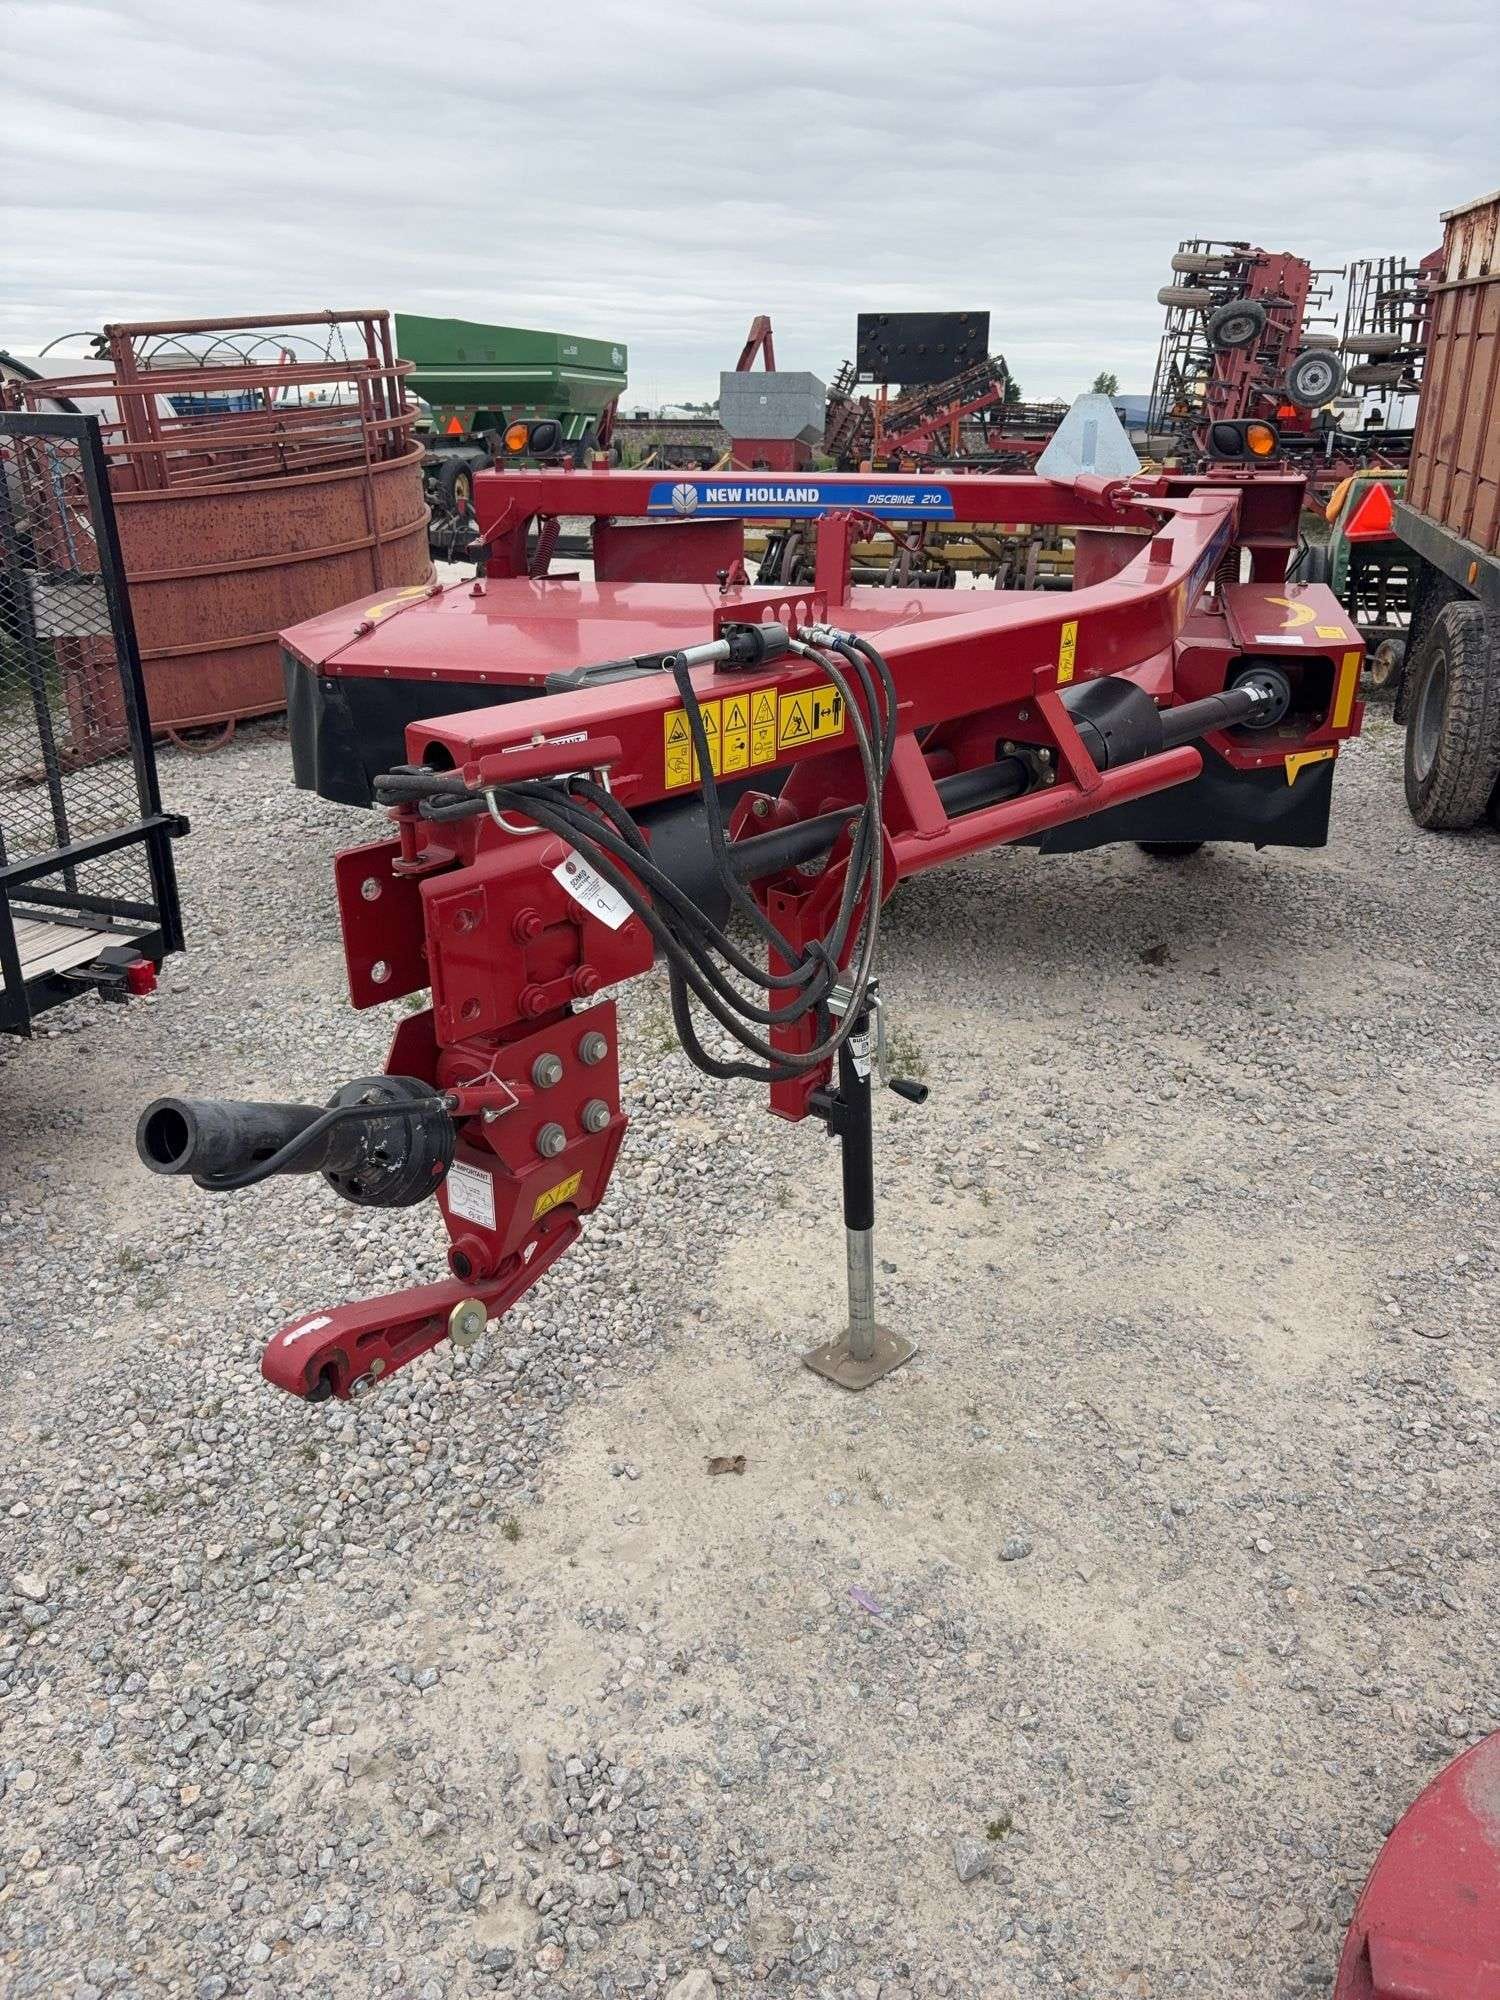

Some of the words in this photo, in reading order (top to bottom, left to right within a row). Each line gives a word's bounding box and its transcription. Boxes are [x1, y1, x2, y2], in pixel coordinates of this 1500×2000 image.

[705, 488, 742, 502] NEW
[745, 488, 820, 503] HOLLAND
[867, 494, 915, 504] DISCBINE
[921, 494, 942, 504] 210
[569, 869, 588, 887] SCHMID
[456, 1163, 488, 1181] IMPORTANT
